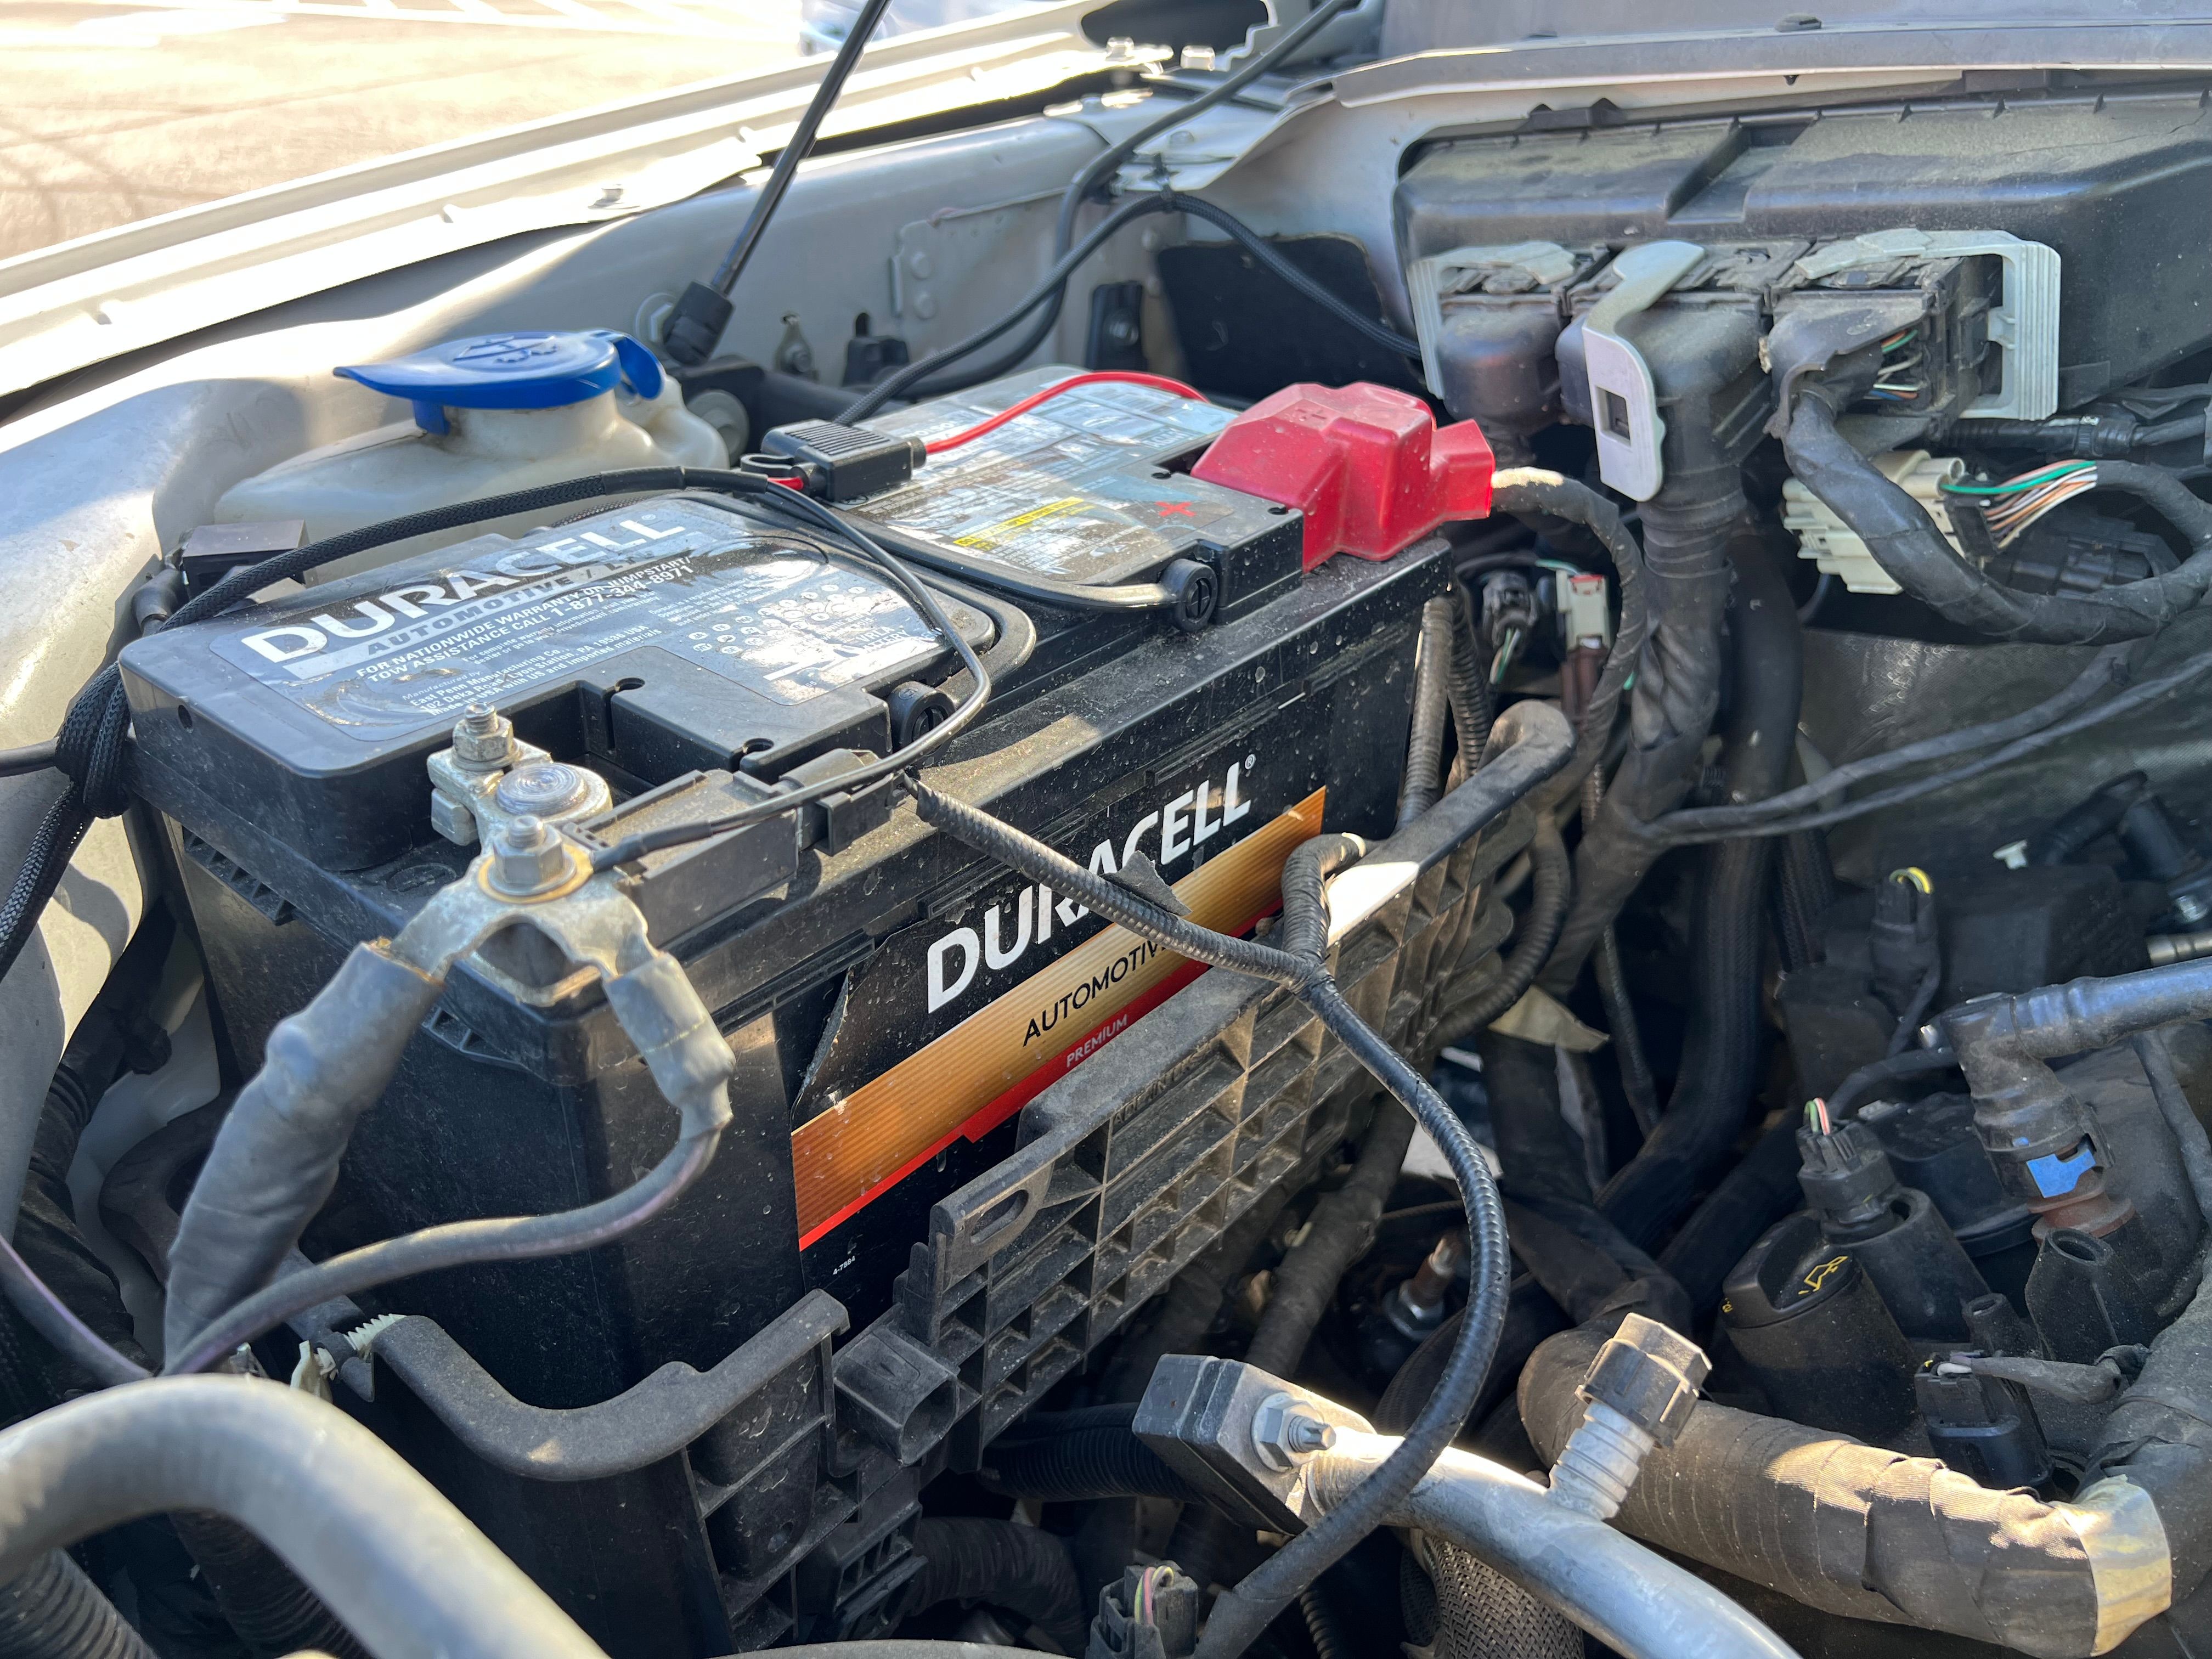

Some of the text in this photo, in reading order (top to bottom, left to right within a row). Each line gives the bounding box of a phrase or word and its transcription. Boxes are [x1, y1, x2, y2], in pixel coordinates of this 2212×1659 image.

[241, 519, 685, 663] DURACELL
[367, 576, 574, 656] AUTOMOTIVE
[367, 664, 408, 682] TOW
[413, 627, 511, 668] ASSISTANCE
[512, 614, 551, 631] CALL
[550, 565, 693, 617] 1-877-344-8971
[356, 661, 390, 678] FOR
[391, 621, 495, 664] NATIONWIDE
[495, 591, 580, 625] WARRANTY
[583, 585, 605, 596] OR
[420, 700, 442, 713] 102
[443, 689, 474, 703] Deka
[506, 665, 535, 679] Lyon
[578, 645, 595, 654] PA
[624, 625, 649, 635] USA
[474, 652, 502, 664] dealer
[514, 642, 526, 651] go
[479, 636, 519, 657] complete
[855, 626, 896, 644] VRLA
[402, 674, 466, 701] Manufactured
[410, 694, 438, 707] East
[438, 684, 465, 697] Penn
[465, 656, 546, 686] Manufacturing
[427, 628, 663, 716] Made in USA with US and imported materials
[1024, 940, 1166, 1047] AUTOMOTIV
[1066, 1013, 1128, 1068] PREMIUM
